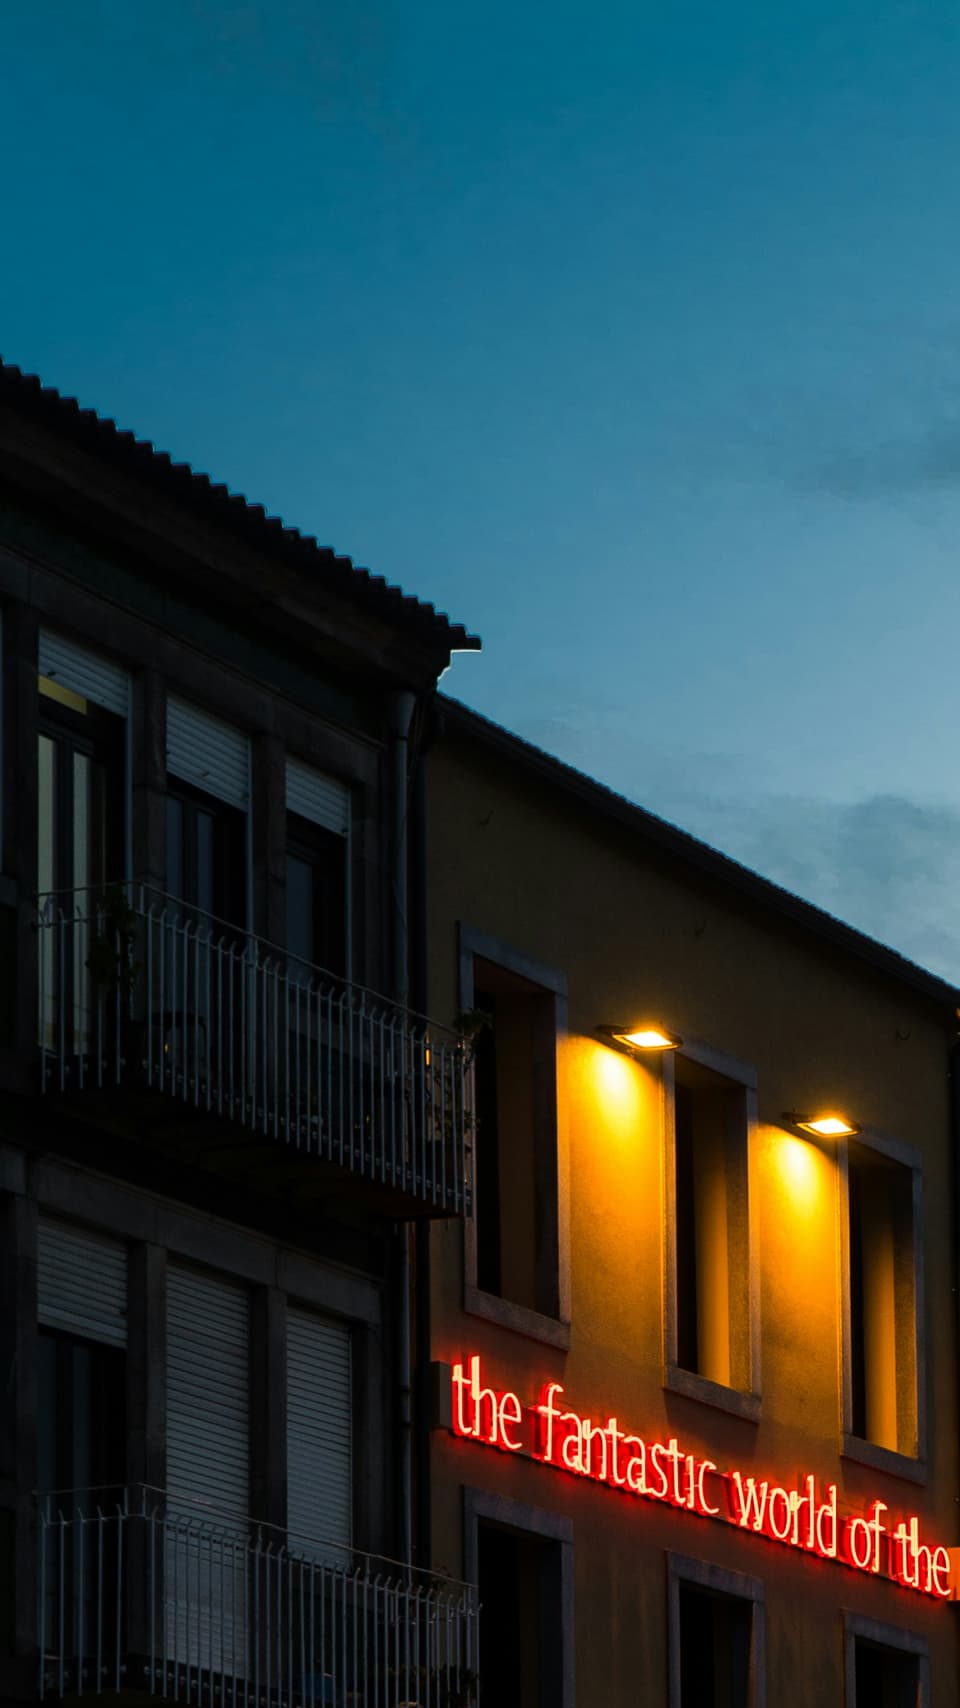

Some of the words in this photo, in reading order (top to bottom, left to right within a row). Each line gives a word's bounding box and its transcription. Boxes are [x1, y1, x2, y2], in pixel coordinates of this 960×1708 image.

[452, 1355, 523, 1450] the
[537, 1382, 721, 1515] fantastic
[733, 1472, 838, 1559] world
[850, 1499, 888, 1573] of
[894, 1516, 952, 1597] the
